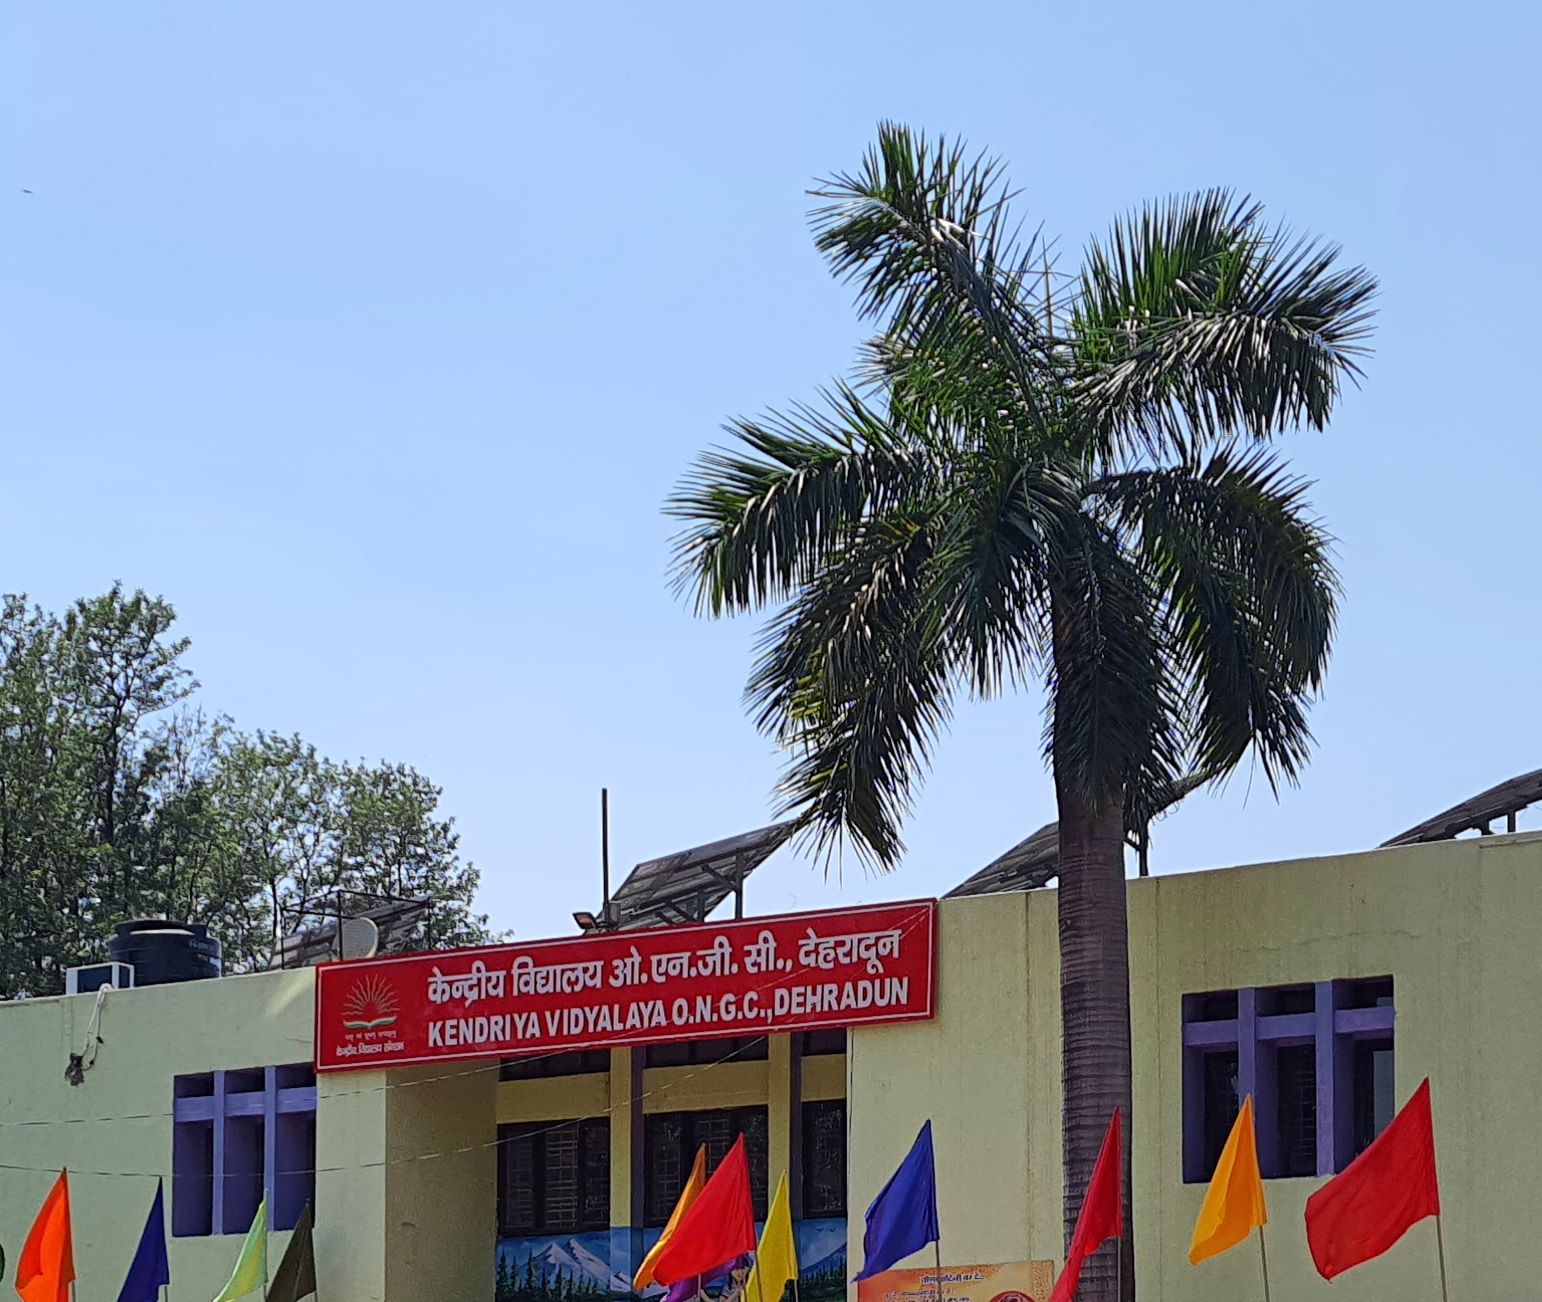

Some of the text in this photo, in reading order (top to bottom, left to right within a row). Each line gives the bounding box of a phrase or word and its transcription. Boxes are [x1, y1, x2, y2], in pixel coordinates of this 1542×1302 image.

[427, 965, 507, 1008] केन्द्रीय
[512, 956, 603, 995] विद्यालय
[798, 926, 903, 975] देहरादून
[428, 1012, 541, 1048] KENDRIYA
[545, 998, 667, 1037] VIDYALAYA
